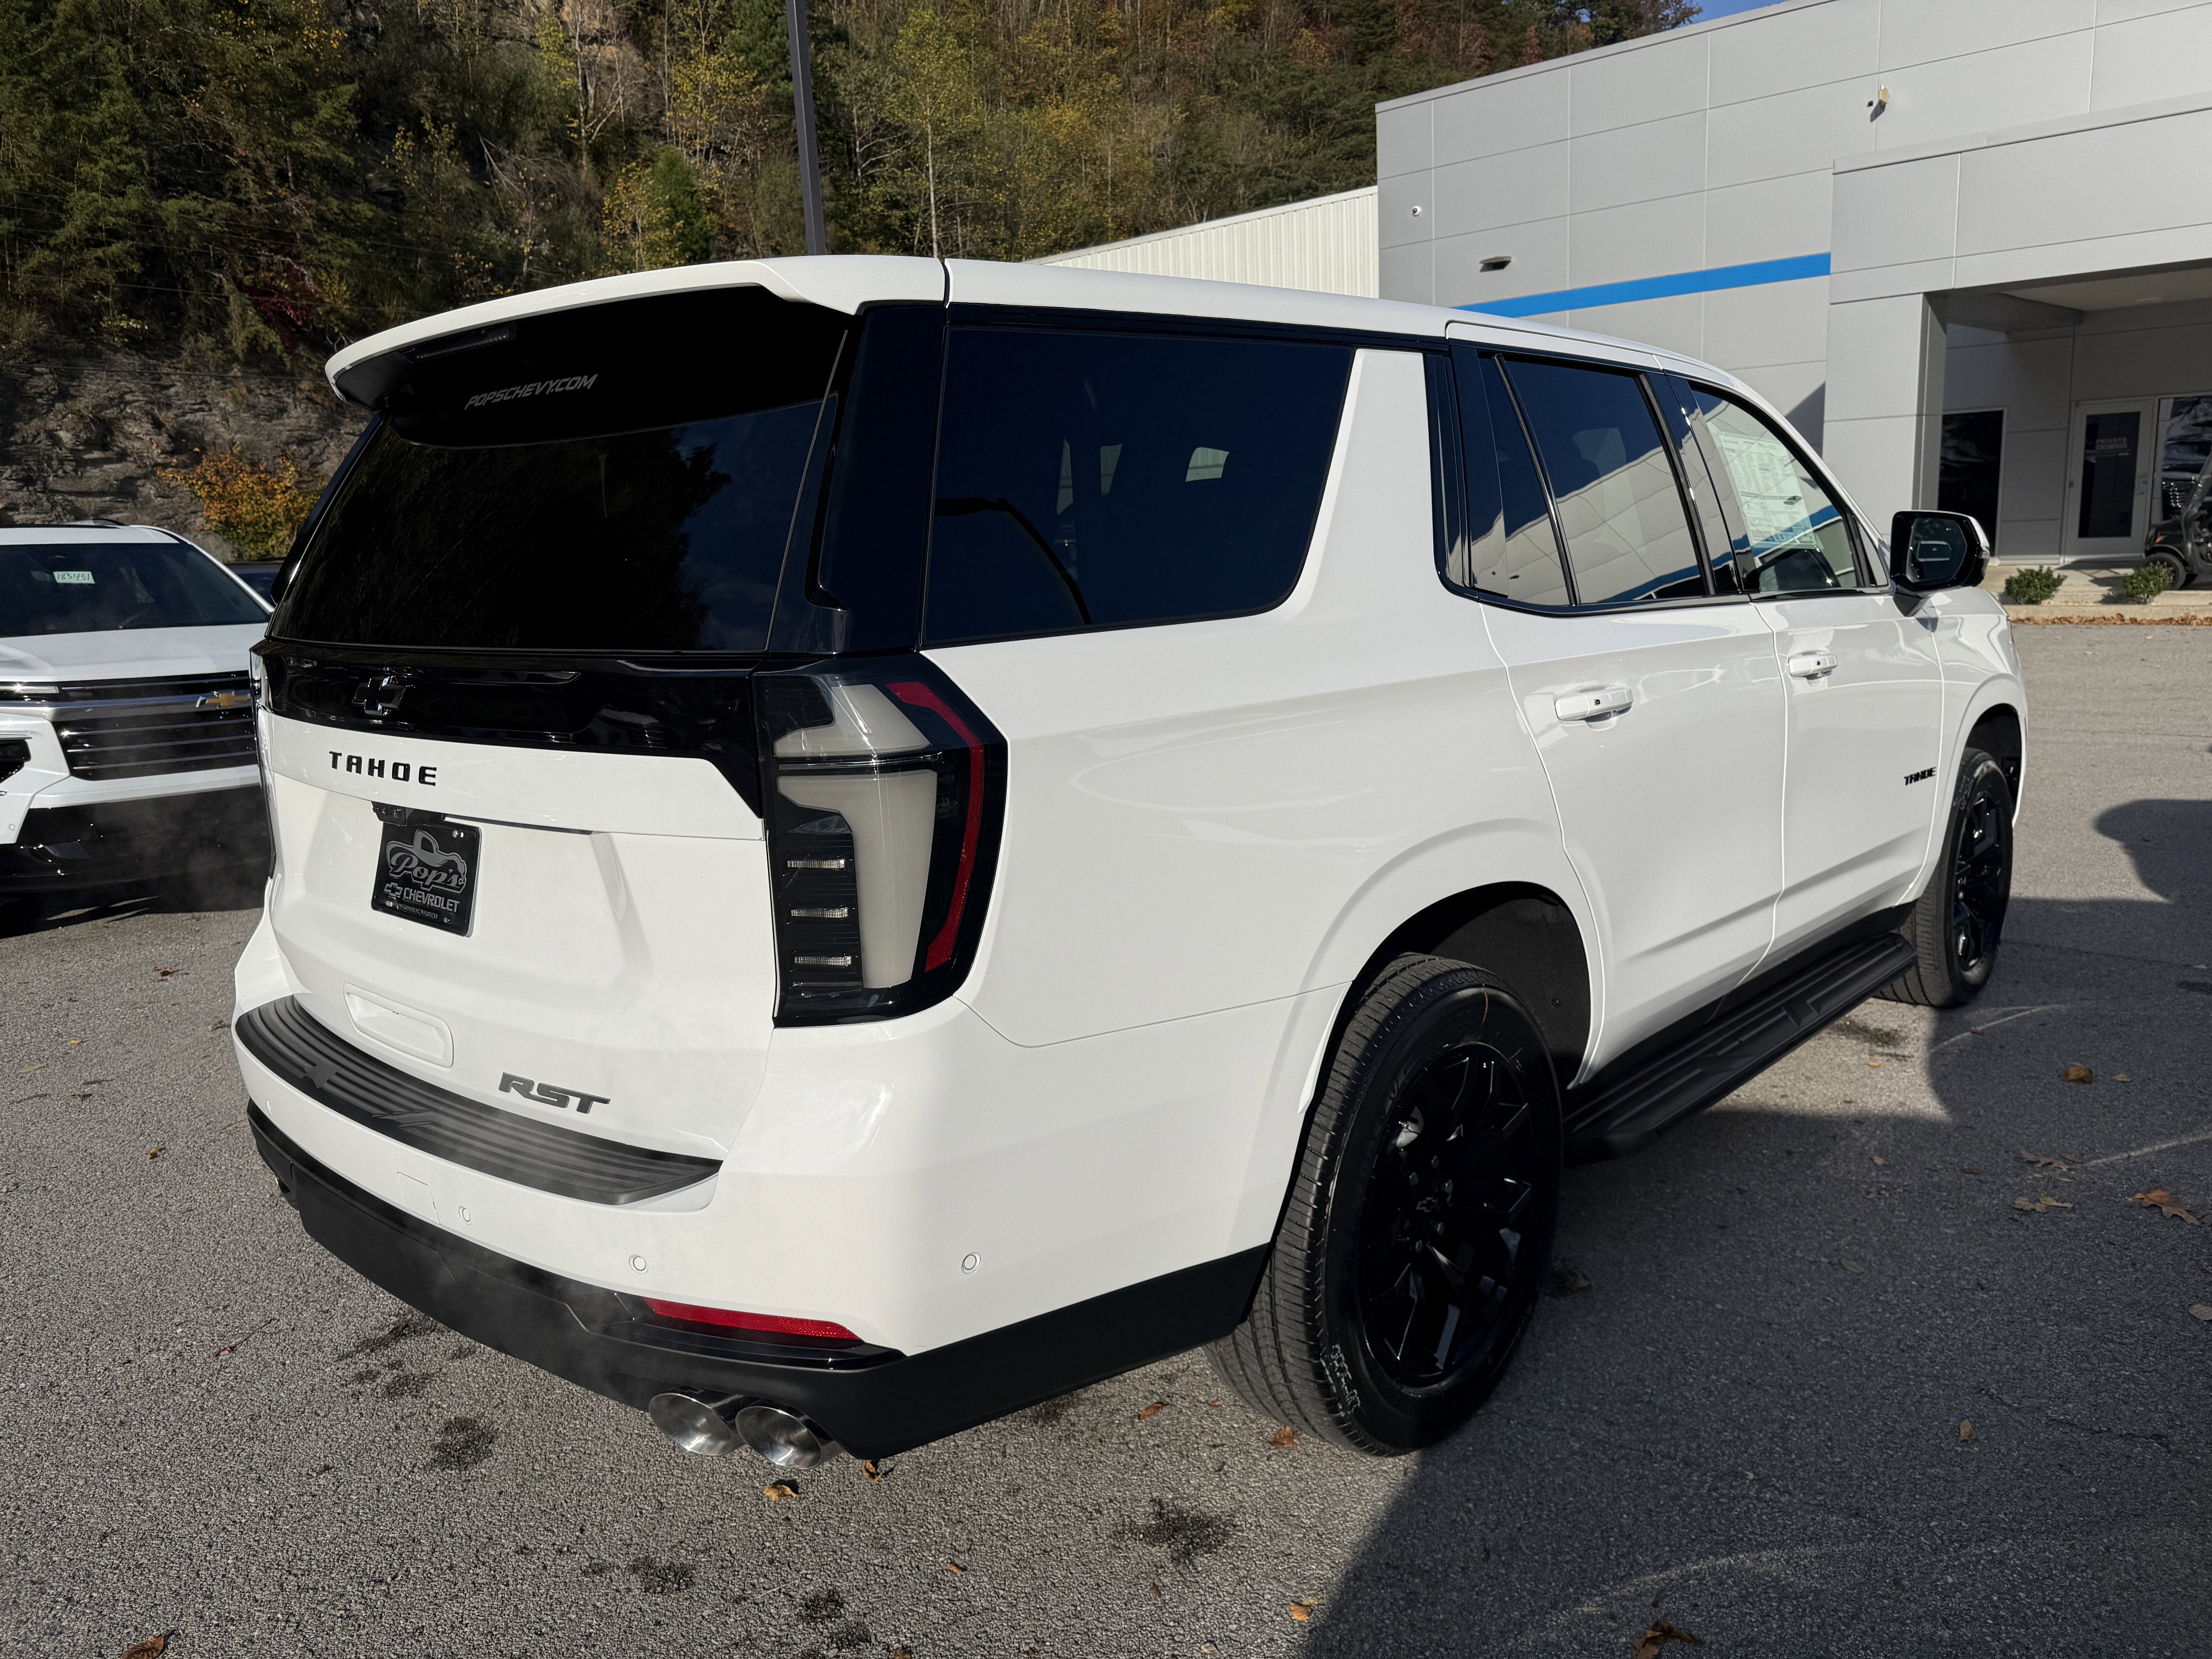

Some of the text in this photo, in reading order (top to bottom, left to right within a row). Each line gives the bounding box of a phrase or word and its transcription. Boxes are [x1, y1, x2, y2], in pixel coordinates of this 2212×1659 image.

[465, 374, 598, 410] POPSCHEVY.COM
[2095, 436, 2127, 445] PRIVATE
[329, 751, 437, 786] TAHOE
[1904, 766, 1936, 786] TAHOE
[390, 852, 460, 888] Pop's
[404, 888, 460, 912] CHEVROLET
[498, 1072, 611, 1114] RST
